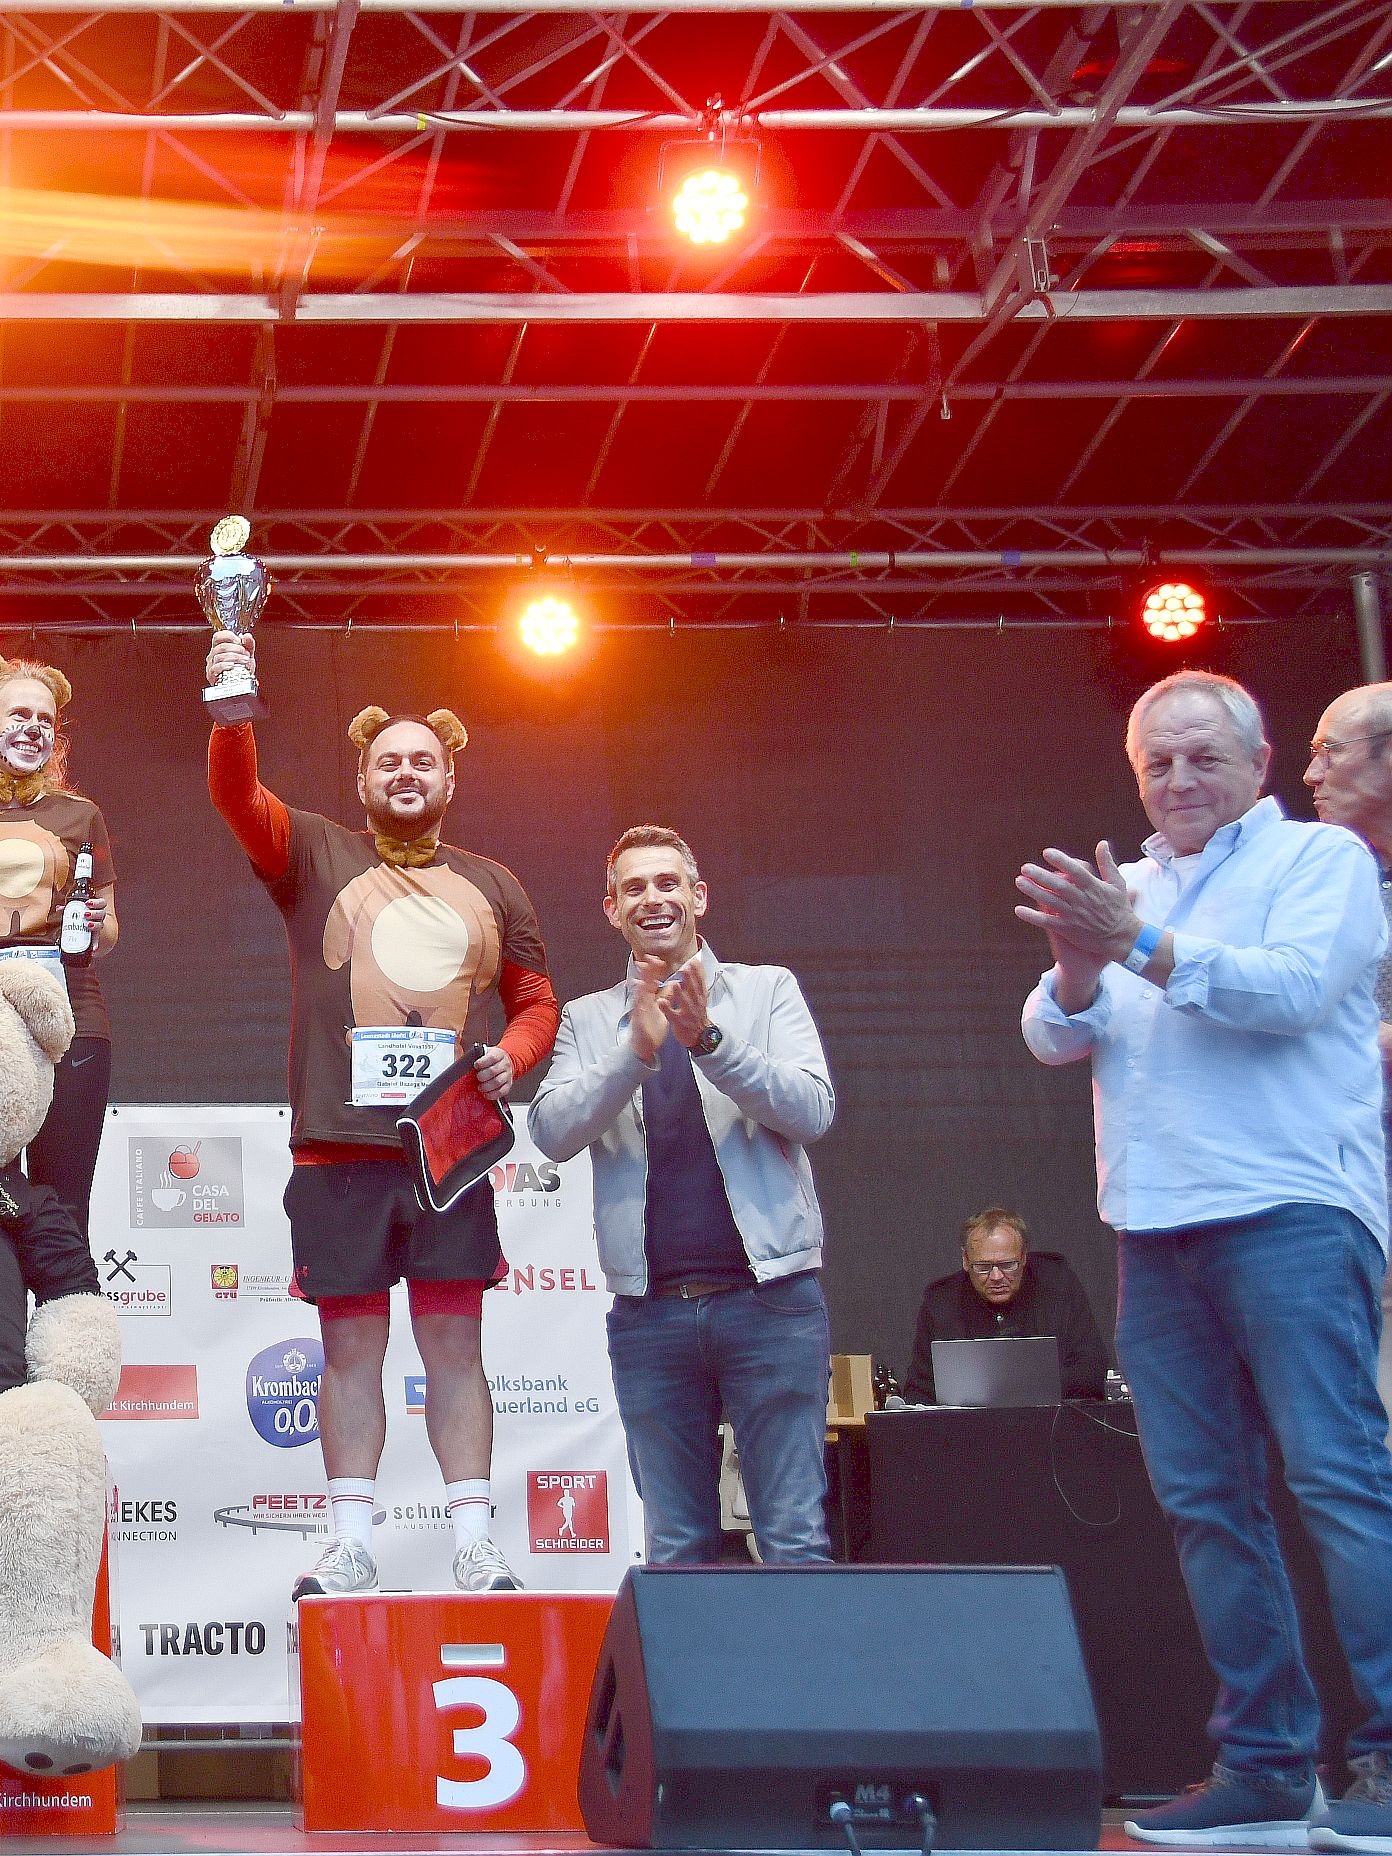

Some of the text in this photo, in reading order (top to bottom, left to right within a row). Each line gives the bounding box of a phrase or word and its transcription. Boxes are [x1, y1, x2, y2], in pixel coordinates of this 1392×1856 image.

[382, 1054, 431, 1078] 322
[135, 1148, 144, 1226] CAFFE ITALIANO
[192, 1185, 229, 1196] CASA
[193, 1198, 219, 1210] DEL
[193, 1213, 240, 1223] GELATO
[104, 1289, 166, 1305] ssgrube
[120, 1400, 194, 1411] Kirchhundem
[574, 1397, 600, 1413] eG
[537, 1475, 597, 1489] SPORT
[253, 1494, 327, 1510] PEETZ
[535, 1538, 604, 1549] SCHNEIDER
[139, 1622, 267, 1656] TRACTO
[432, 1676, 525, 1808] 3
